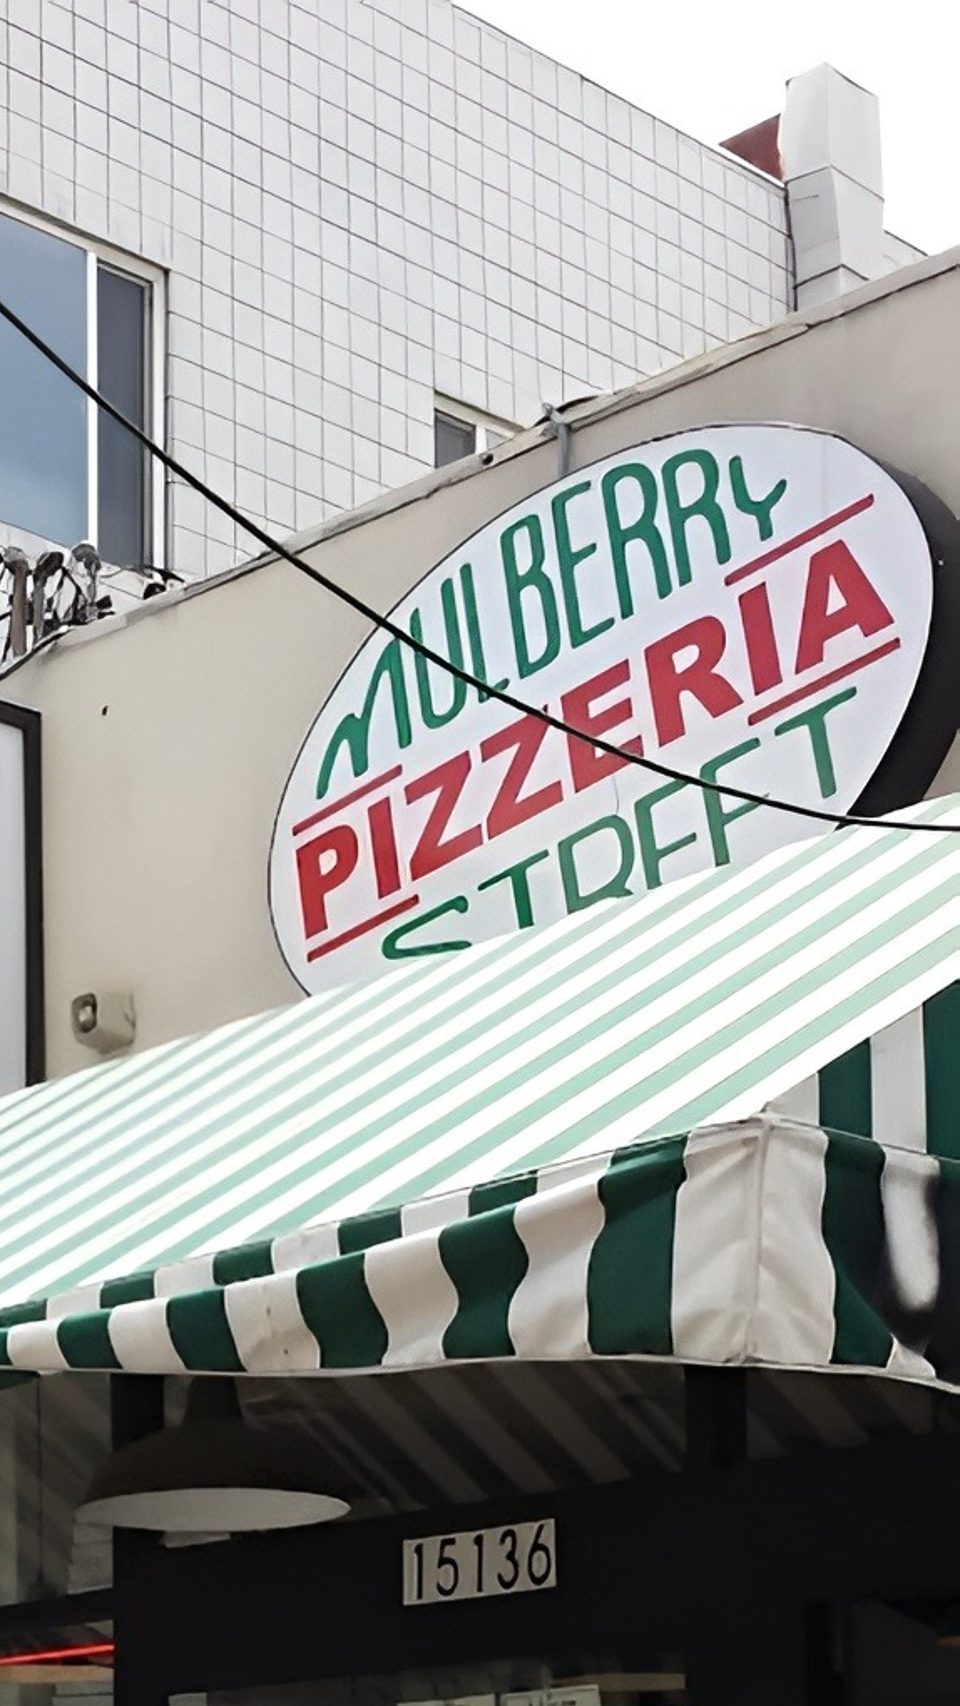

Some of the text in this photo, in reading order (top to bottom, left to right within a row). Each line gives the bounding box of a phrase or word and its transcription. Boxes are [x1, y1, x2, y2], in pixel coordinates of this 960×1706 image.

[294, 538, 896, 940] PIZZERIA
[316, 447, 787, 800] MULBERRY
[413, 1523, 551, 1600] 15136
